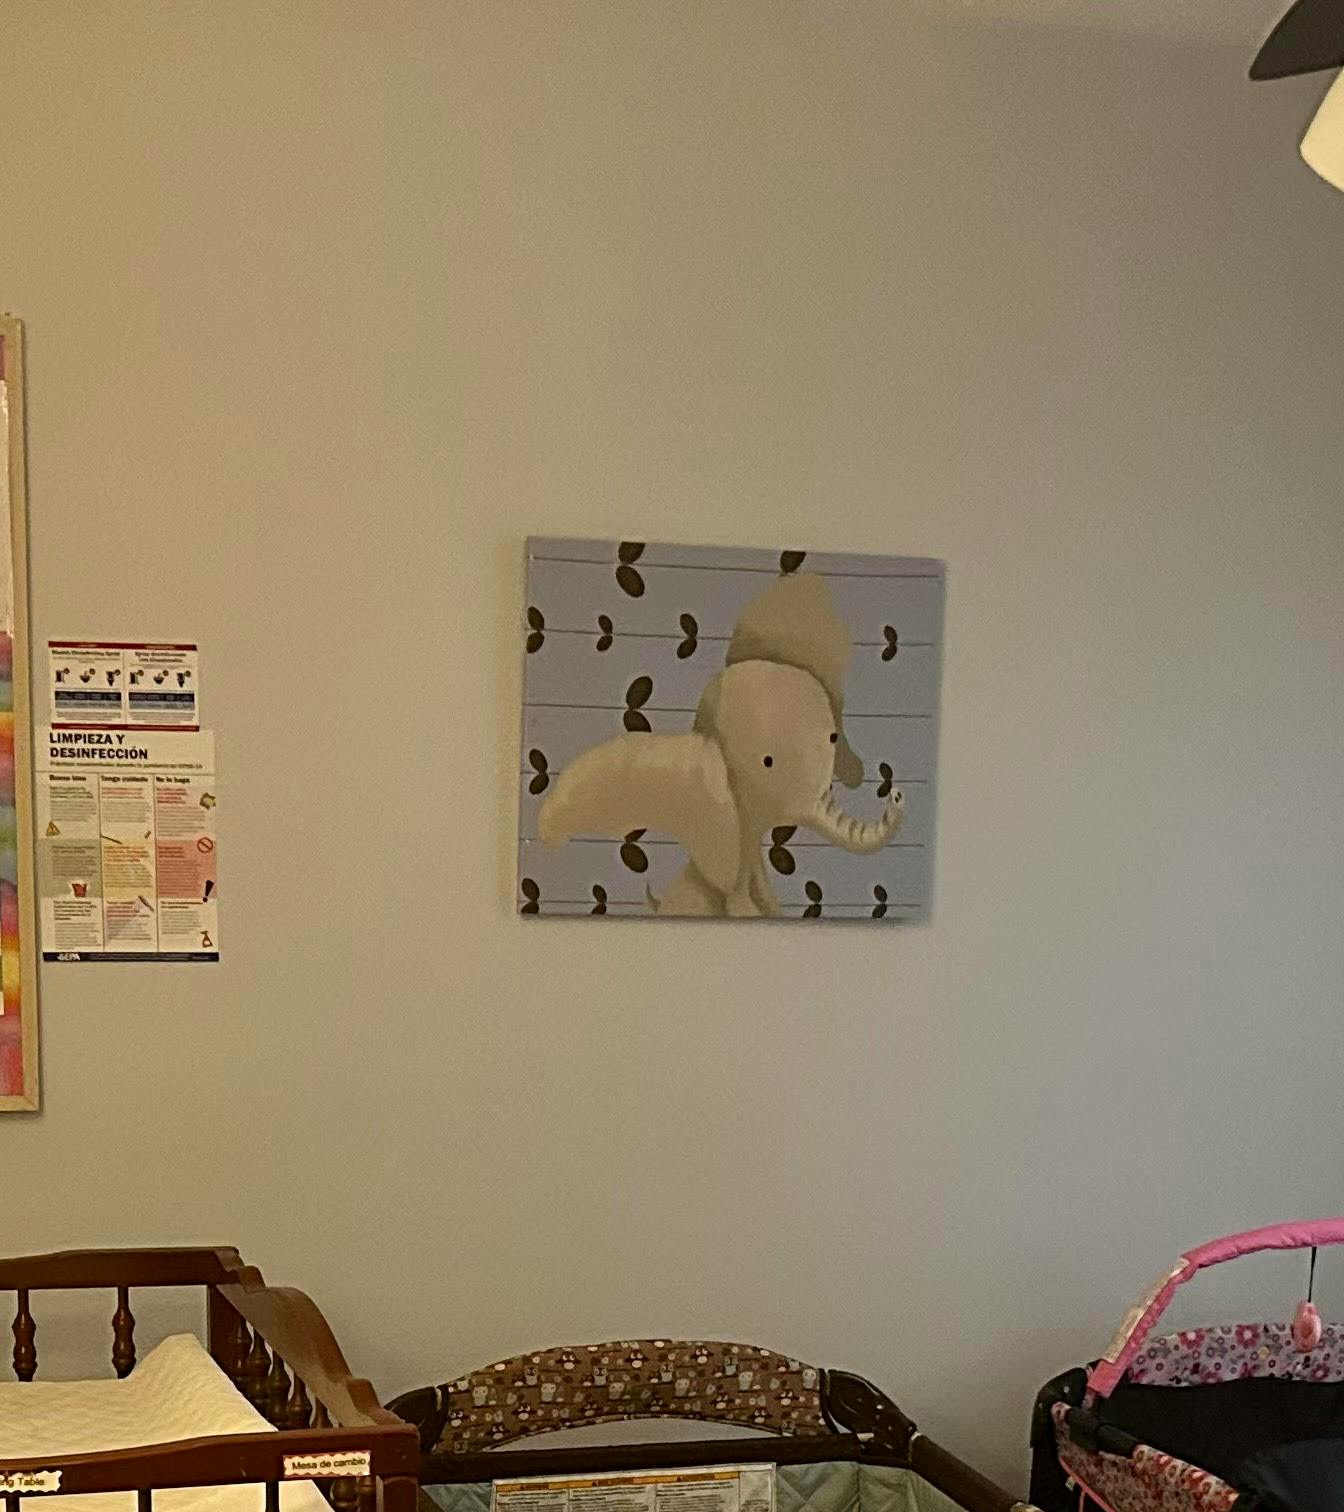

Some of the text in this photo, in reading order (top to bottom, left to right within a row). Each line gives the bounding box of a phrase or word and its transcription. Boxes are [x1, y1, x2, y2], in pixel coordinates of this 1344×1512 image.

[49, 732, 126, 745] LIMPIEZA Y
[49, 745, 149, 760] DESINFECCIÓN
[291, 1457, 367, 1471] Mesa de cambio
[17, 1477, 46, 1487] Table
